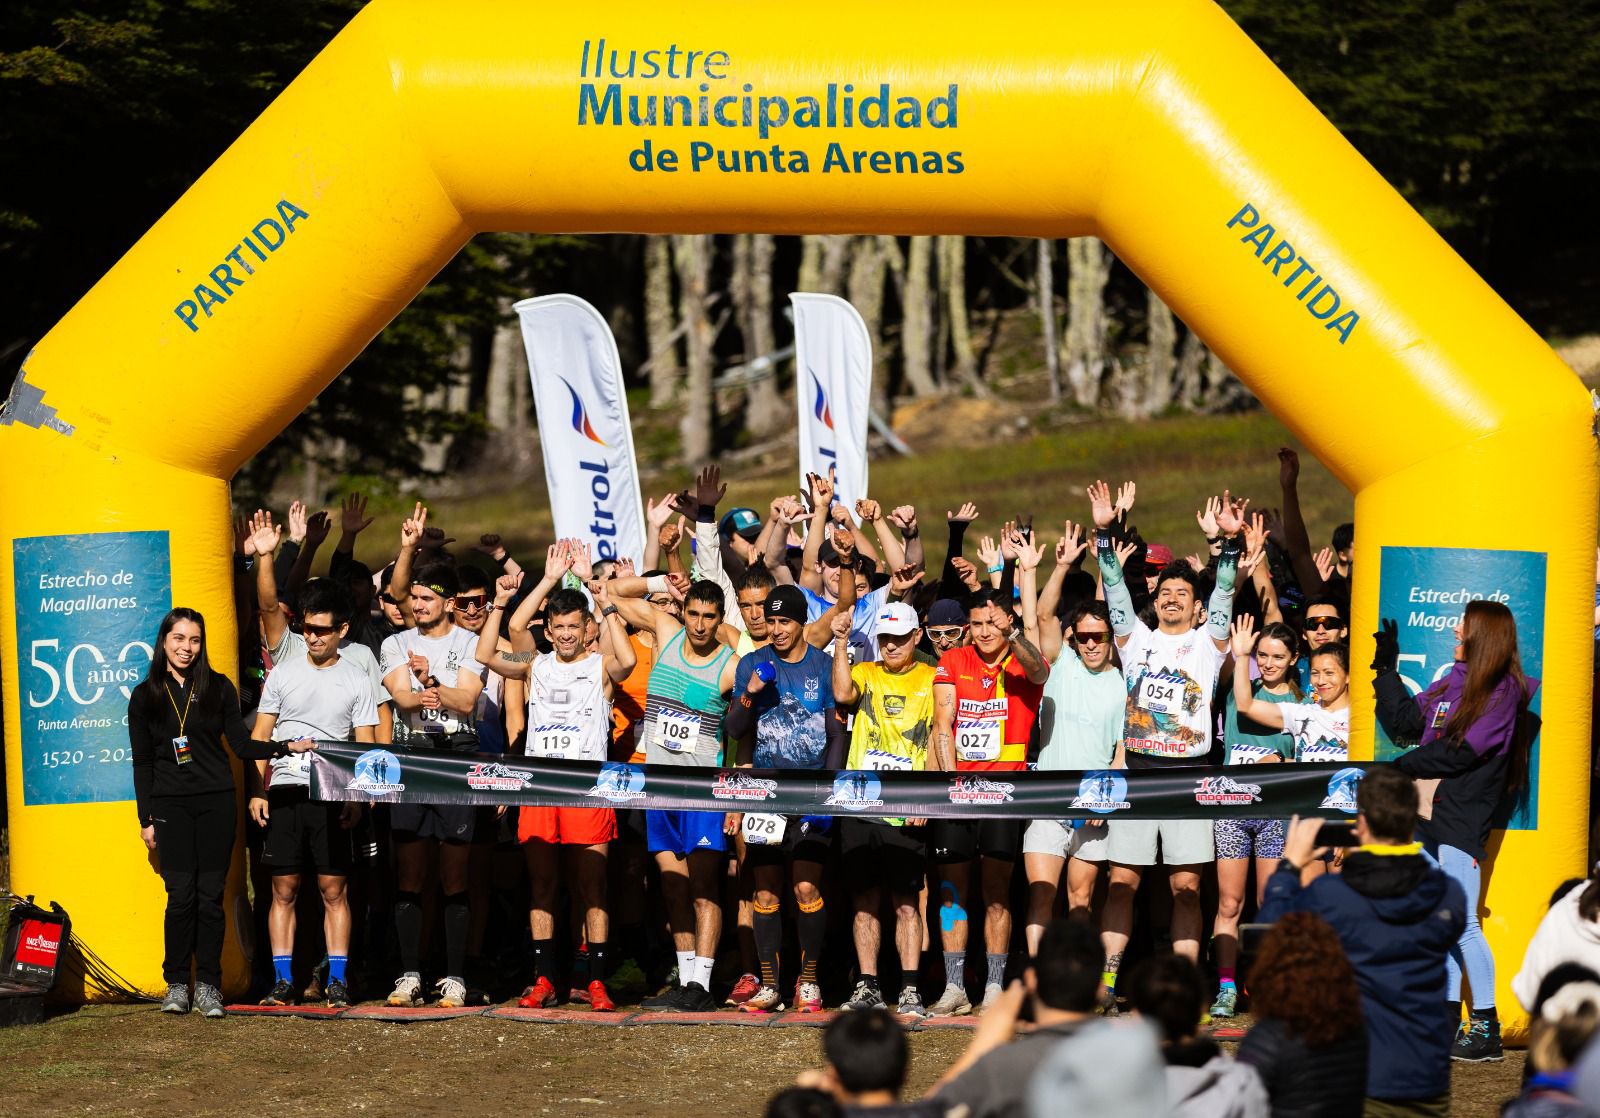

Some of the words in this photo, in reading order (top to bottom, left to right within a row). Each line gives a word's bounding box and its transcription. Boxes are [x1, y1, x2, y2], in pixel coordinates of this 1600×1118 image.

[580, 39, 730, 79] Ilustre
[578, 83, 958, 139] Municipalidad
[629, 139, 678, 172] de
[690, 141, 810, 173] Punta
[822, 142, 965, 174] Arenas
[174, 200, 309, 333] PARTIDA
[1226, 203, 1360, 345] PARTIDA
[580, 458, 618, 561] etrol
[39, 570, 108, 590] Estrecho
[111, 569, 134, 587] de
[40, 594, 137, 616] Magallanes
[88, 664, 139, 683] años
[1147, 683, 1174, 701] 054
[961, 701, 1004, 712] HITACHI
[38, 719, 68, 730] Punta
[70, 717, 112, 729] Arenas
[663, 721, 690, 739] 108
[543, 736, 571, 749] 119
[961, 733, 991, 748] 027
[43, 750, 84, 768] 1520
[747, 816, 776, 834] 078
